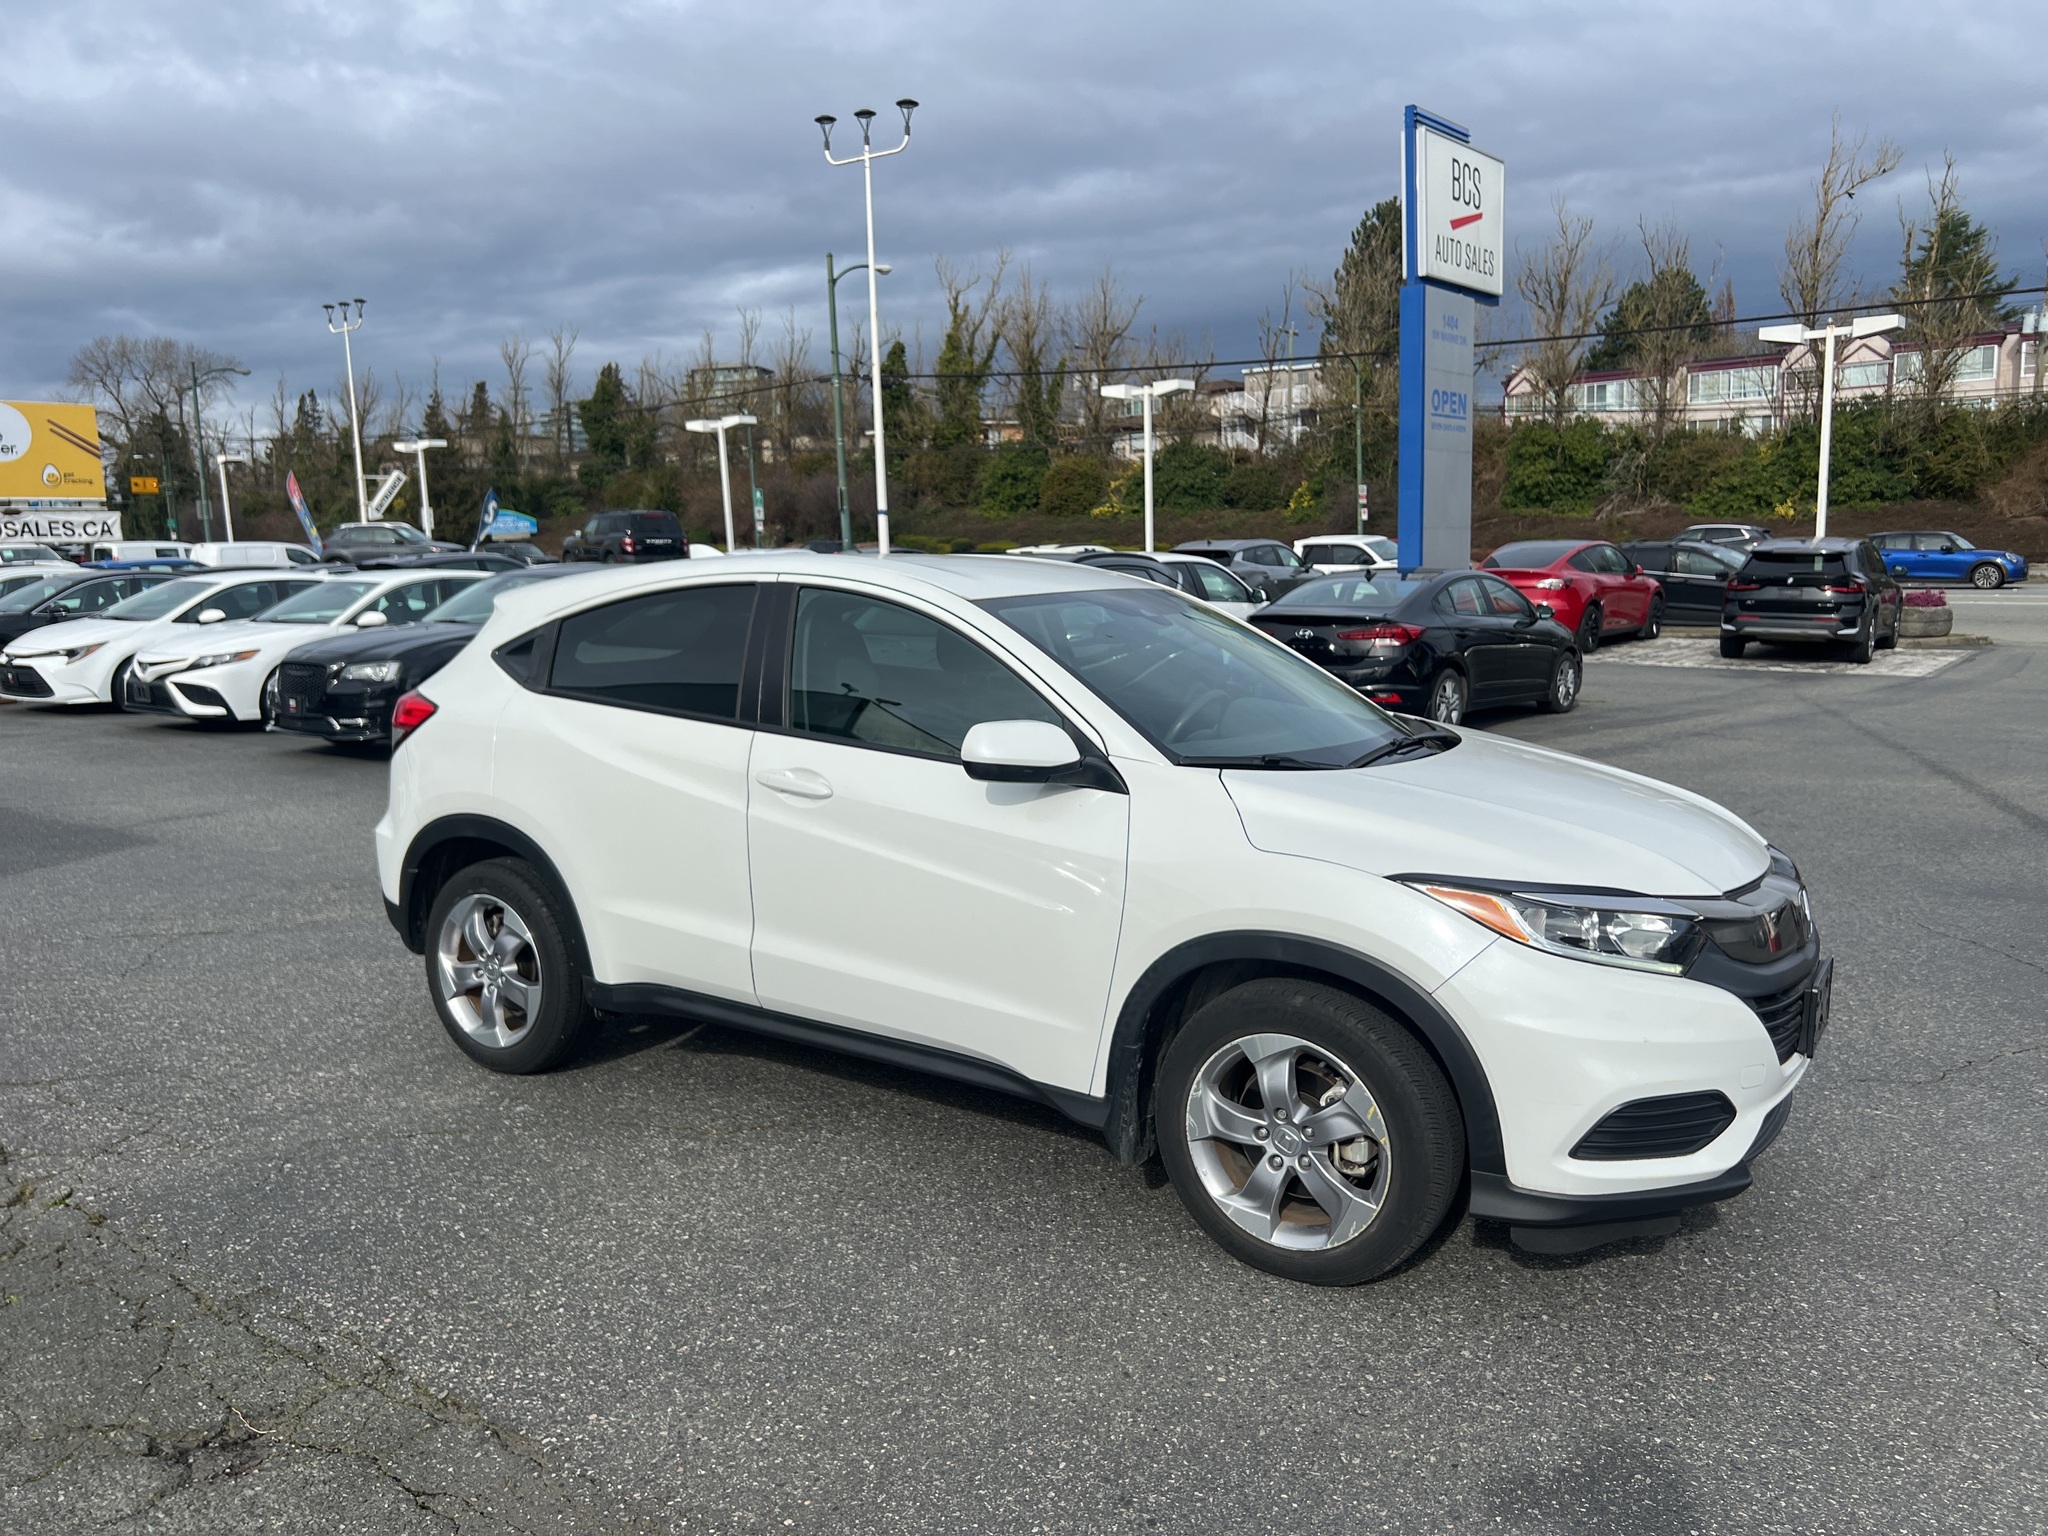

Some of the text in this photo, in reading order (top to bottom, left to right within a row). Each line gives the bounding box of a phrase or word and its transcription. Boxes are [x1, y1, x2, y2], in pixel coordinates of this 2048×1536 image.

[1451, 157, 1482, 210] BCS
[1435, 234, 1494, 277] AUTO SALES
[1431, 388, 1467, 416] OPEN
[0, 519, 114, 538] SALES.CA
